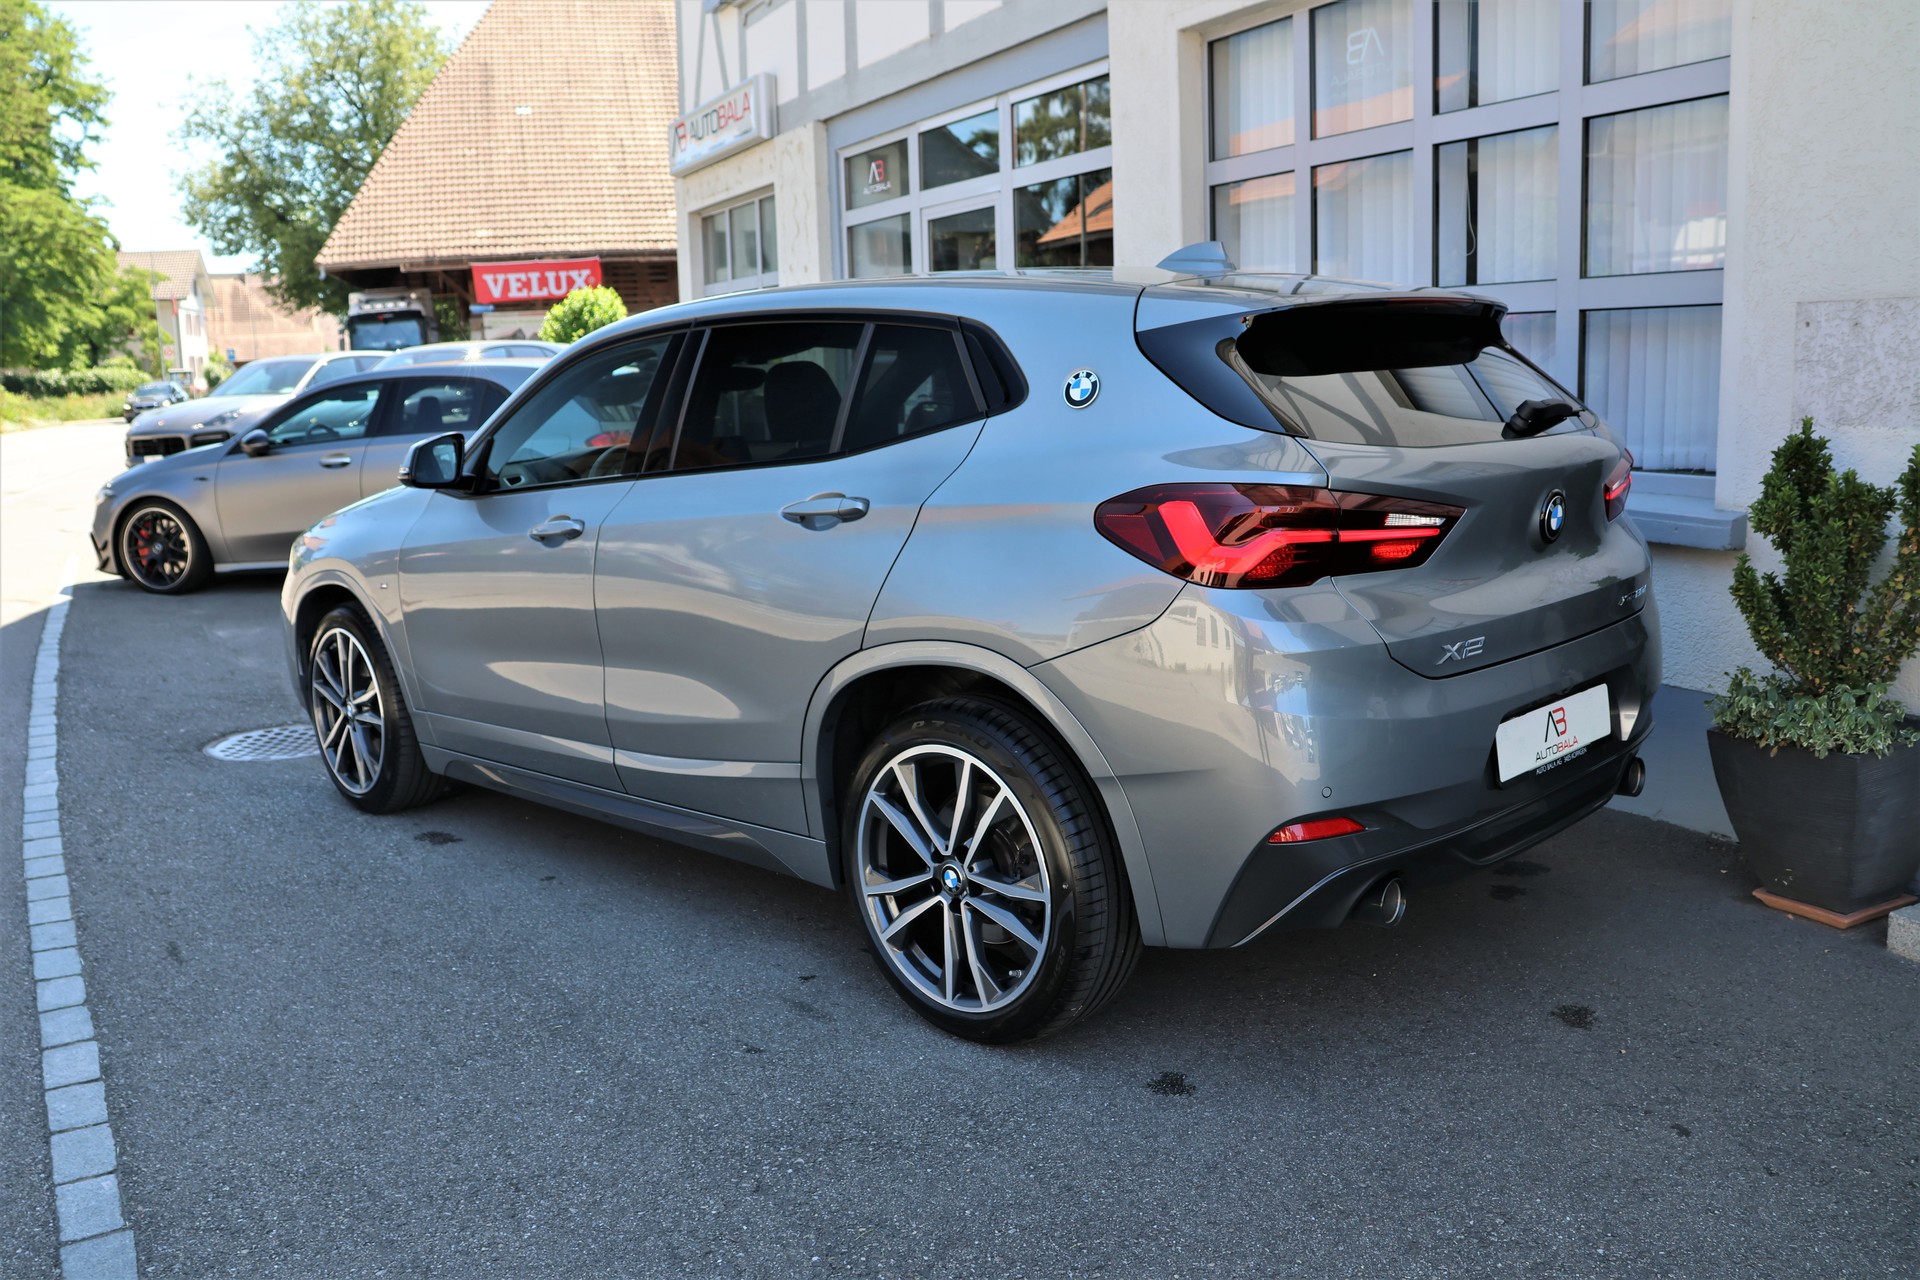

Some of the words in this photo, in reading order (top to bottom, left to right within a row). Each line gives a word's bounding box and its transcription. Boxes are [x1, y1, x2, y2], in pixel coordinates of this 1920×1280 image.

[690, 91, 751, 140] AUTOBALA
[1436, 636, 1485, 665] X2
[1535, 735, 1578, 762] AUTOBALA
